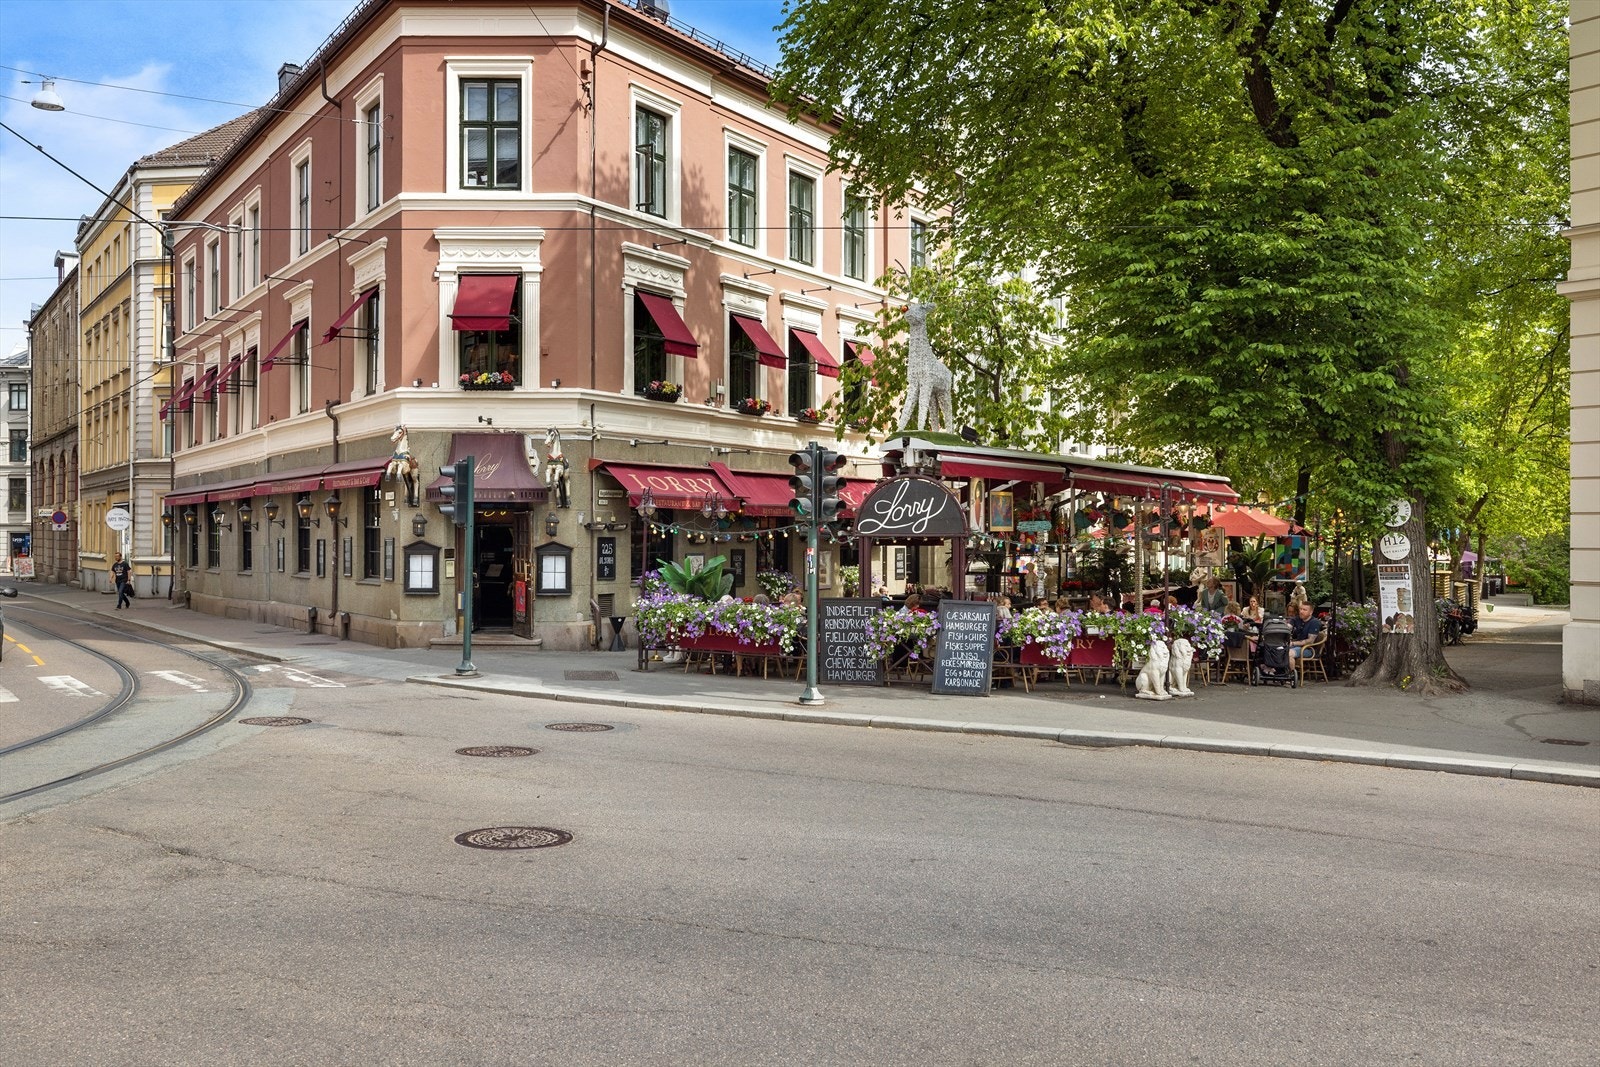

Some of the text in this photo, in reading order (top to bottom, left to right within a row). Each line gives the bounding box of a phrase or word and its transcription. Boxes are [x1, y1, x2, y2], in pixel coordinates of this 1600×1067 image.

[857, 480, 948, 534] Lorry
[1383, 535, 1405, 546] H12
[825, 605, 876, 617] INDREFILET
[945, 622, 988, 632] HAMBURGER
[948, 631, 964, 641] FISH
[968, 633, 988, 642] CHIPS
[828, 645, 857, 657] CÆSAR
[825, 657, 857, 669] CHEVRE
[827, 670, 877, 681] HAMBURGER
[945, 668, 957, 677] EGG
[963, 669, 984, 678] BACON
[944, 678, 981, 688] KARBONADE
